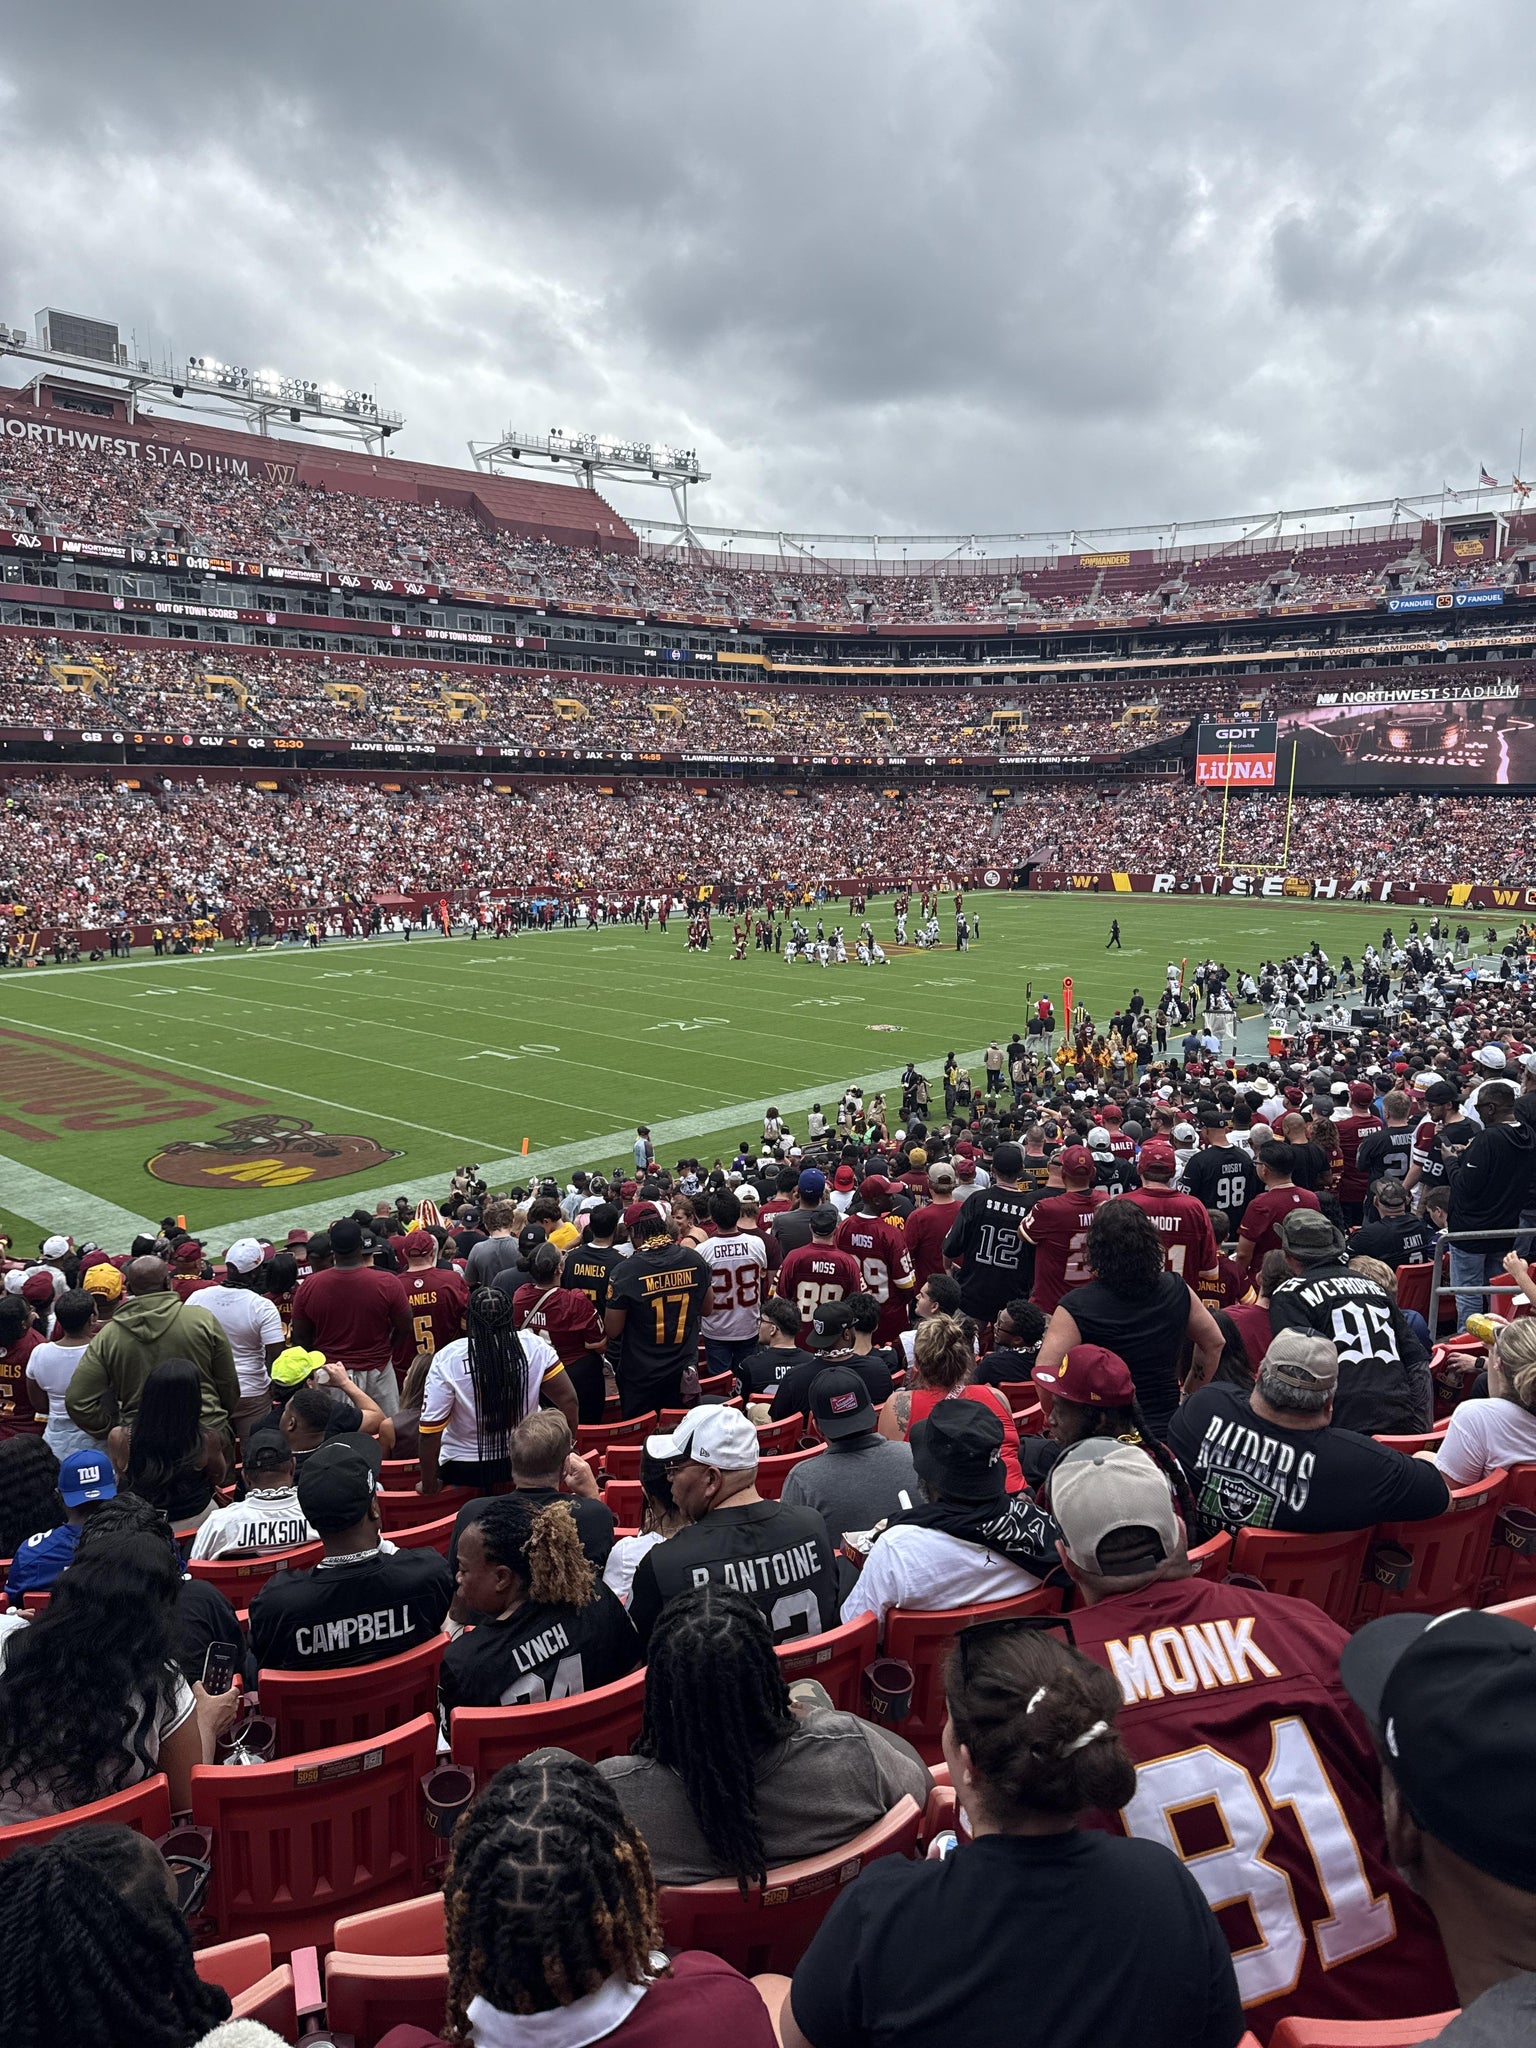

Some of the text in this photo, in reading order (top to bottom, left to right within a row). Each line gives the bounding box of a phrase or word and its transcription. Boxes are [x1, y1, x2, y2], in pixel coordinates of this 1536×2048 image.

[82, 543, 126, 555] NORTHWEST
[150, 551, 159, 560] 3
[186, 556, 210, 570] 0:16
[239, 562, 246, 571] 7
[1080, 555, 1130, 565] COMMANDERS
[285, 570, 322, 579] NORTHWEST
[1401, 600, 1433, 608] FANDUEL
[1467, 594, 1502, 603] FANDUEL
[155, 602, 239, 620] OUT OF TOWN SCORES
[425, 629, 493, 644] OUT OF TOWN SCORES
[1486, 637, 1511, 645] 1942
[1329, 647, 1366, 655] WORLD
[1368, 642, 1431, 653] CHAMPIONS
[695, 653, 713, 661] PEPSI
[1342, 688, 1440, 703] NORTHWEST
[1442, 685, 1520, 699] STADIUM
[1268, 710, 1275, 718] 7
[81, 732, 103, 742] GB
[134, 734, 143, 743] 3
[164, 735, 174, 744] 0
[199, 737, 223, 746] CLV
[247, 738, 265, 748] Q2
[273, 740, 304, 748] 12:30
[1215, 728, 1260, 739] GDIT
[350, 743, 436, 753] J.LOVE (GB) 5-7-33
[500, 749, 519, 757] HST
[620, 753, 633, 761] Q2
[639, 753, 661, 761] 14:55
[925, 758, 936, 766] Q1
[1198, 761, 1273, 779] LiUNA!
[1152, 874, 1285, 896] RISE
[655, 1015, 730, 1032] 20
[473, 1042, 561, 1061] 10
[1110, 1142, 1134, 1152] BAILEY
[1221, 1163, 1243, 1175] CROSBY
[1421, 1155, 1445, 1176] 98
[1216, 1175, 1247, 1209] 98
[1146, 1217, 1182, 1232] MOOT
[851, 1233, 874, 1249] MOSS
[978, 1223, 1022, 1270] 12
[1402, 1234, 1423, 1250] JEANTY
[713, 1243, 749, 1259] GREEN
[573, 1264, 607, 1279] DANIELS
[811, 1261, 835, 1275] MOSS
[645, 1271, 692, 1292] McLAURIN
[711, 1263, 760, 1311] 28
[407, 1291, 438, 1307] ANIELS
[651, 1293, 690, 1344] 17
[412, 1315, 436, 1355] 5
[1331, 1300, 1402, 1365] 95
[1193, 1414, 1315, 1513] RAIDERS
[1224, 1480, 1256, 1499] RAIDERS
[237, 1519, 308, 1548] JACKSON
[725, 1540, 822, 1594] ANTOINE
[295, 1605, 414, 1655] CAMPBELL
[511, 1623, 569, 1673] LYNCH
[1105, 1616, 1282, 1705] MONK
[1118, 1715, 1398, 2009] 81
